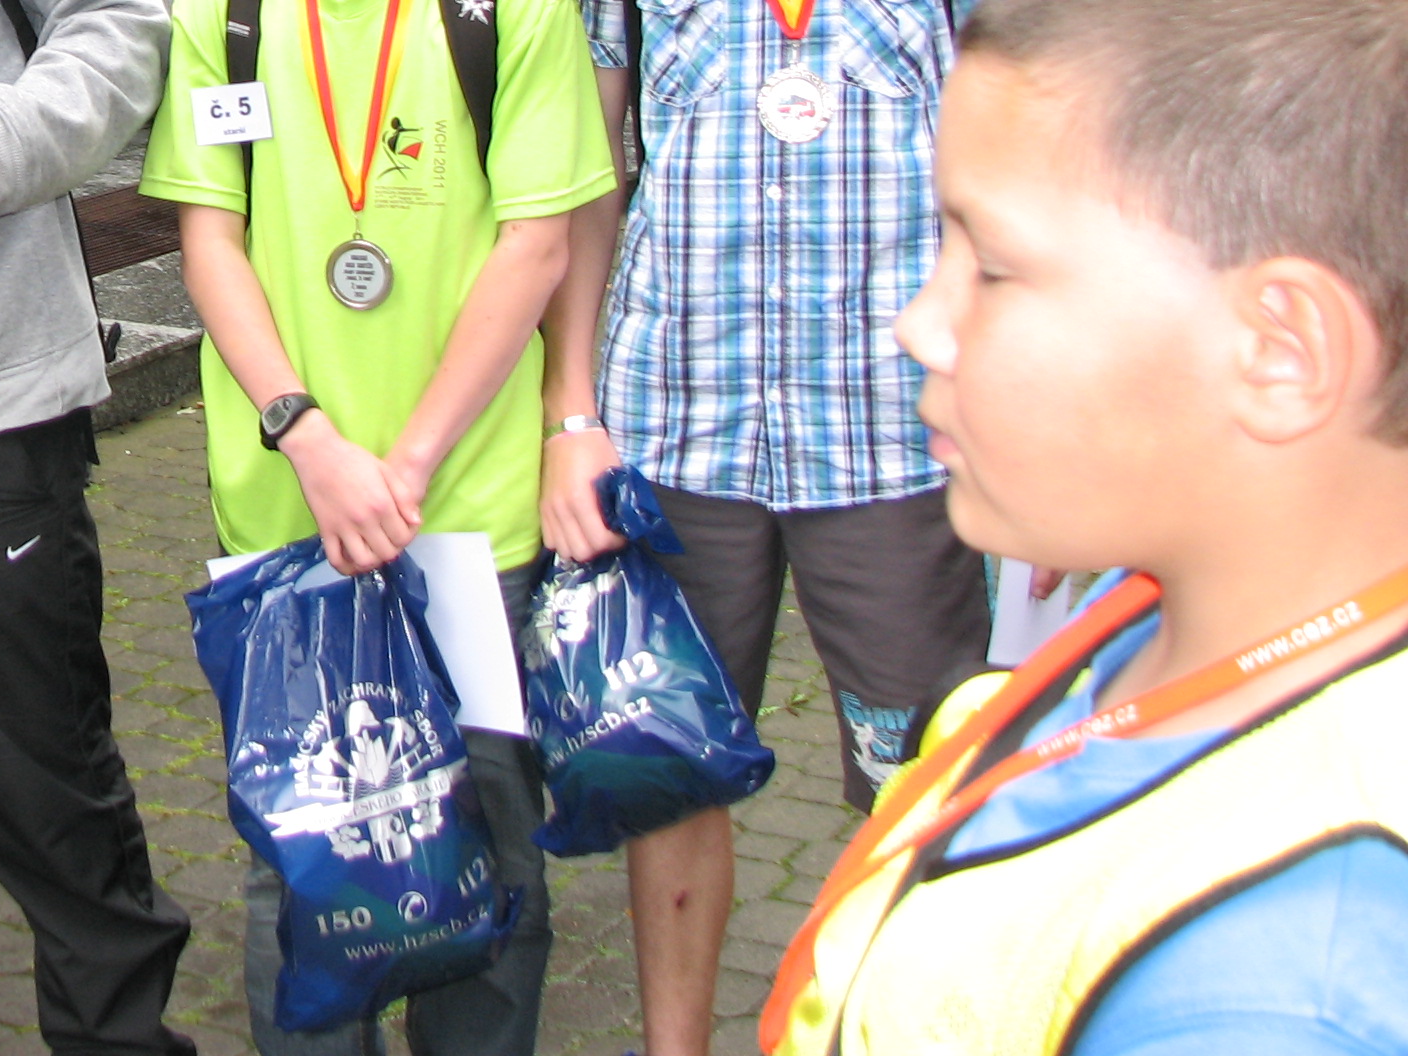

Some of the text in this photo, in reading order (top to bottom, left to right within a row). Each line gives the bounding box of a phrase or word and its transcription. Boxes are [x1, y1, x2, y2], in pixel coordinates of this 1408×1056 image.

[210, 96, 252, 119] č. 5
[433, 119, 447, 188] WCH 2011
[603, 650, 659, 691] 112
[456, 856, 489, 897] 112
[315, 906, 372, 936] 150
